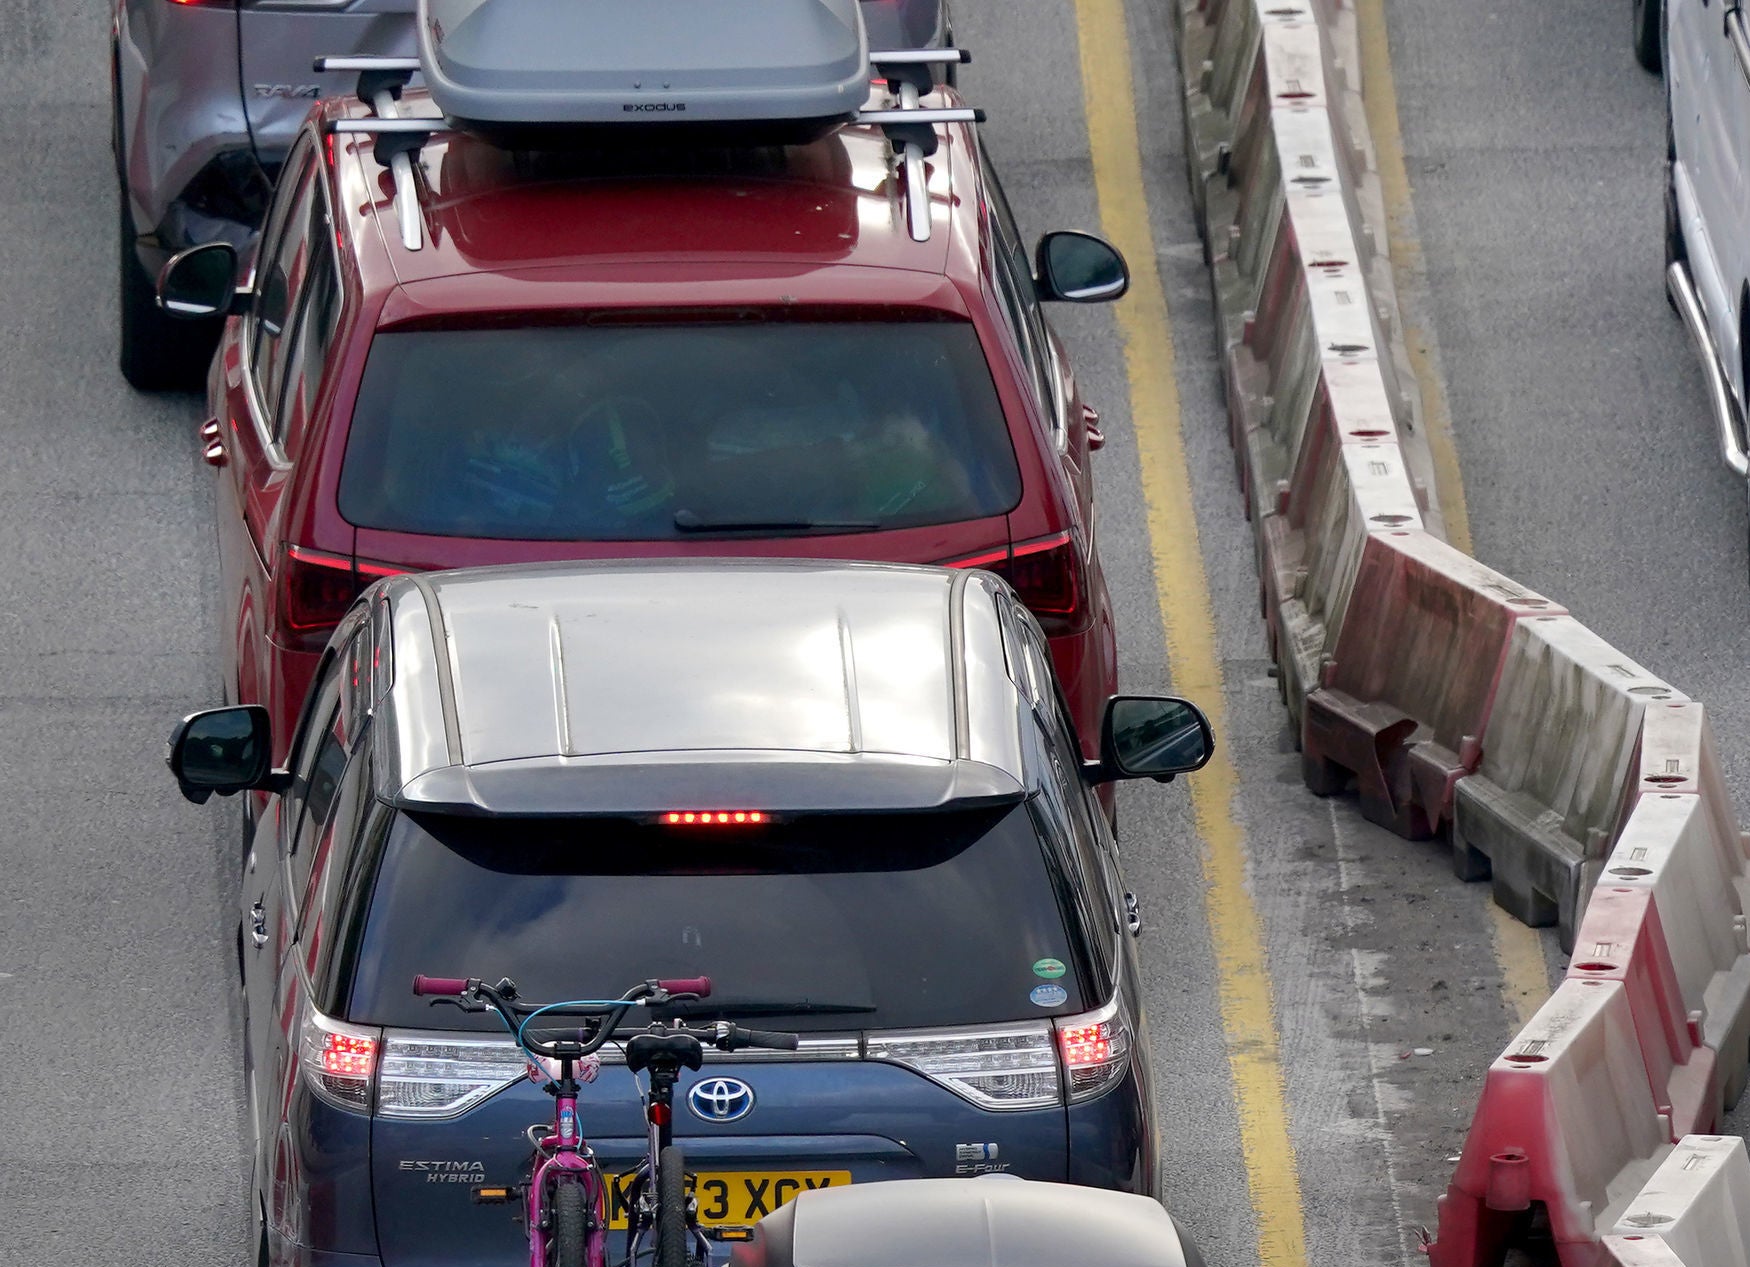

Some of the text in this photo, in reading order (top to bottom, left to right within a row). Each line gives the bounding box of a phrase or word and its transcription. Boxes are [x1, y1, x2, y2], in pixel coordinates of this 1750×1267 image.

[623, 103, 686, 112] exodus
[399, 1161, 484, 1171] ESTIMA
[956, 1163, 1010, 1174] E-Four
[426, 1173, 485, 1183] HYBRID
